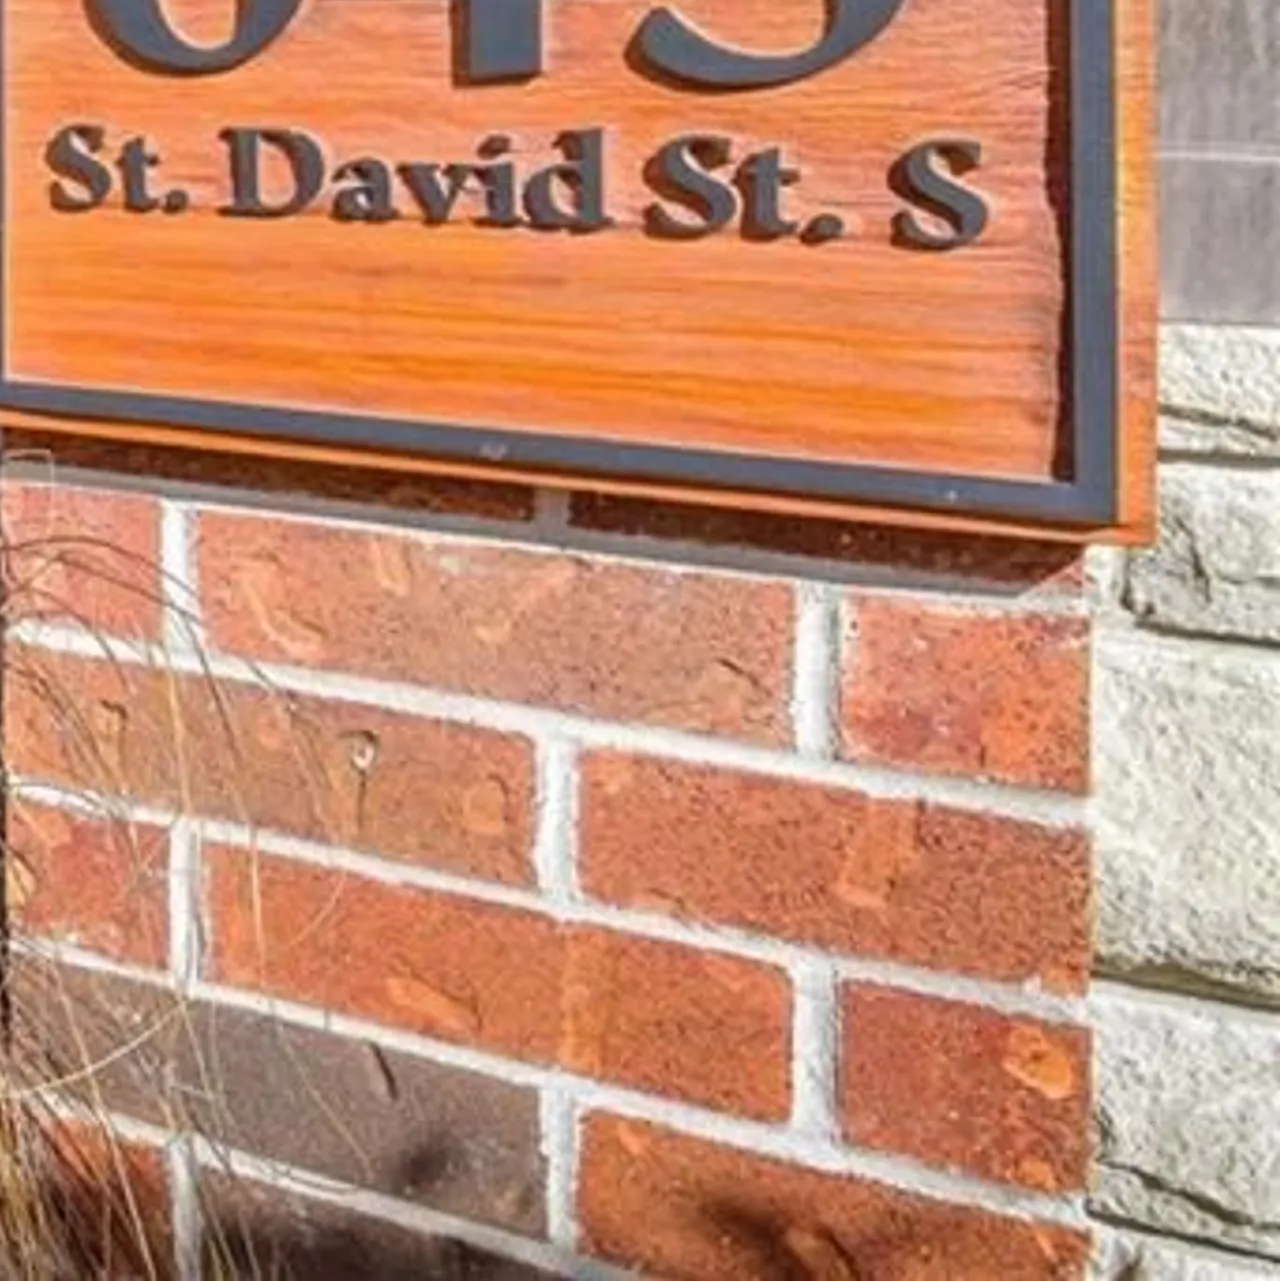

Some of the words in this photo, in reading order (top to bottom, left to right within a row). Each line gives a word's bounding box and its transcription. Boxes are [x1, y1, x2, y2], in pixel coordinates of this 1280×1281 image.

[46, 124, 188, 215] St.
[220, 126, 613, 232] David
[642, 136, 844, 241] St.
[888, 141, 989, 250] S
